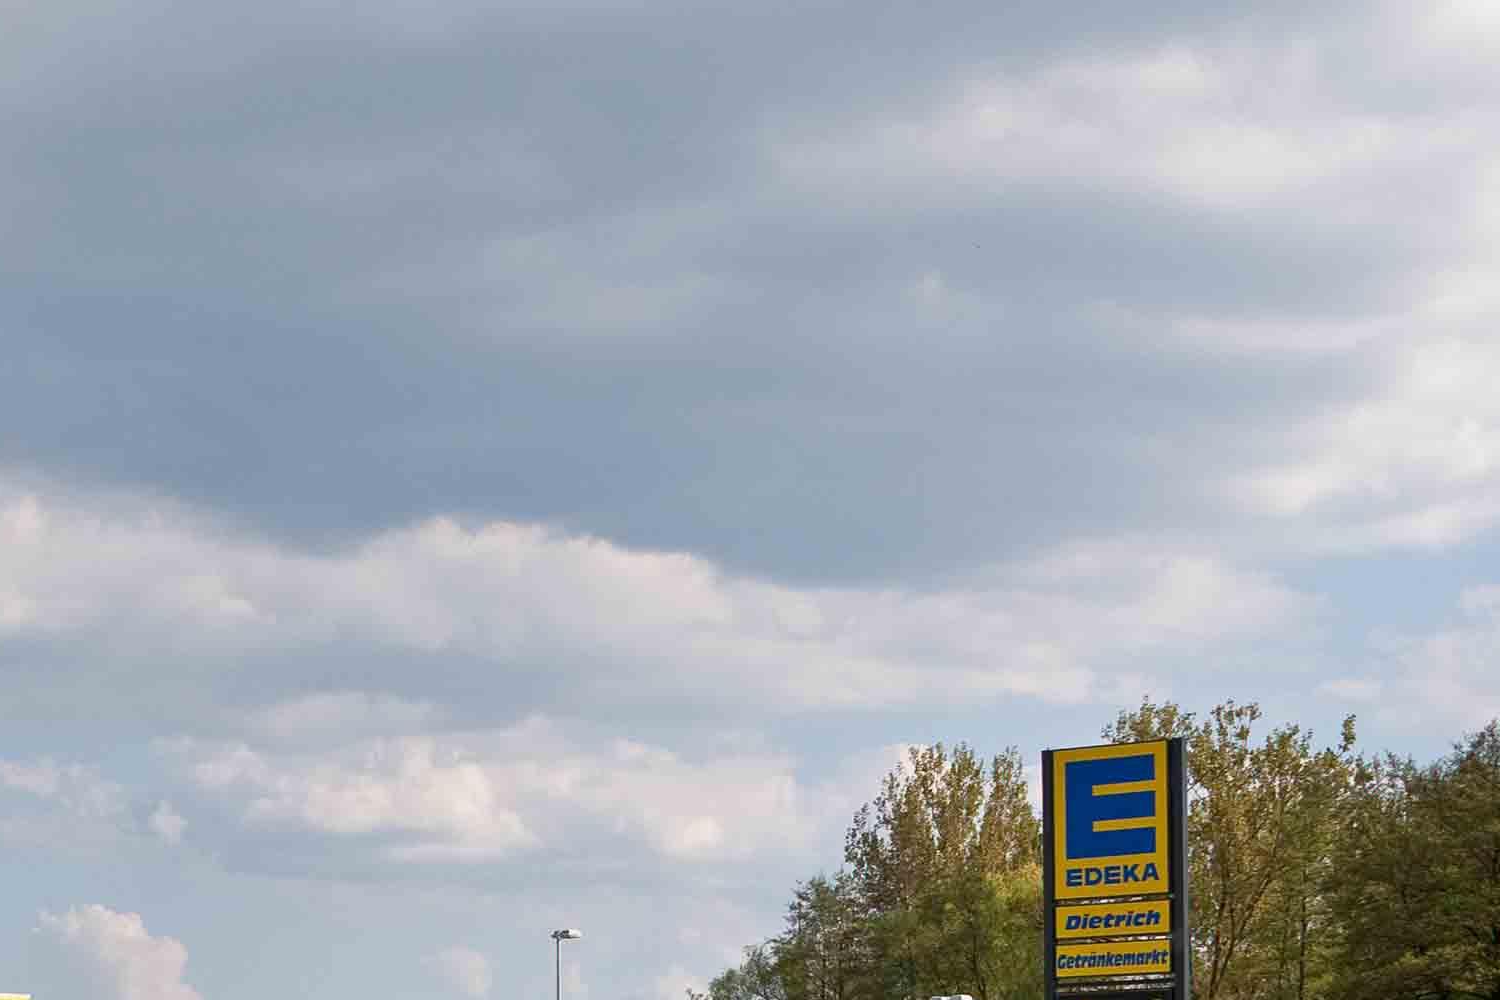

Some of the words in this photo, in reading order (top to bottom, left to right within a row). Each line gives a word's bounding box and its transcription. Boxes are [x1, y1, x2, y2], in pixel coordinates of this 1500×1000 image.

[1065, 754, 1156, 860] E
[1065, 862, 1160, 887] EDEKA
[1065, 910, 1161, 930] Dietrich
[1058, 949, 1168, 969] Getränkemarkt
